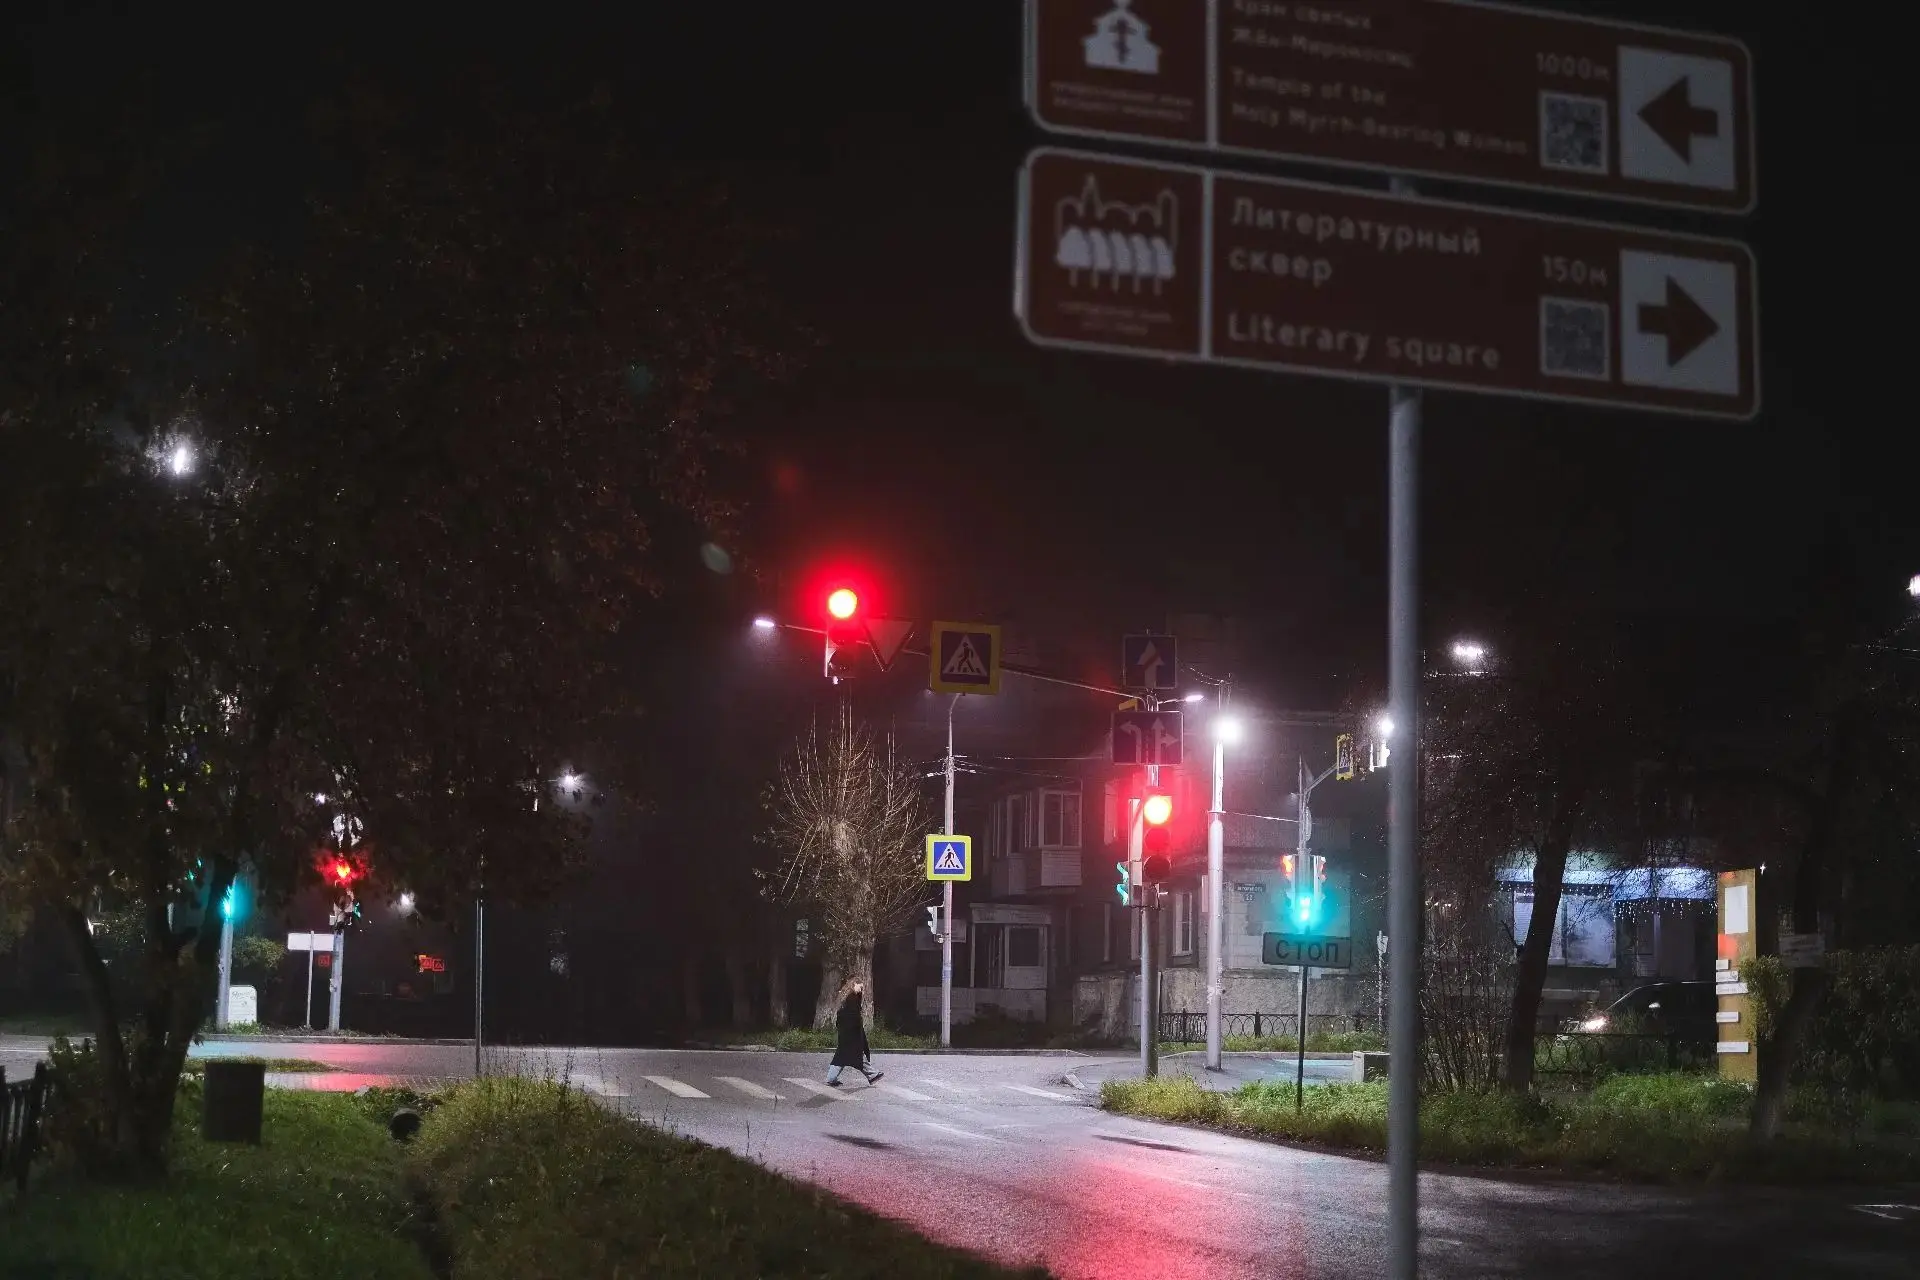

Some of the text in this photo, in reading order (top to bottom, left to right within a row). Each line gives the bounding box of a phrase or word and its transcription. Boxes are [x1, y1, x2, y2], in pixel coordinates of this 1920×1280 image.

[1232, 66, 1313, 98] Temple
[1320, 82, 1343, 99] of
[1230, 196, 1481, 256] Литературный
[1541, 253, 1608, 288] 150м
[1227, 311, 1500, 370] Literary square
[1275, 939, 1339, 963] СТОП
